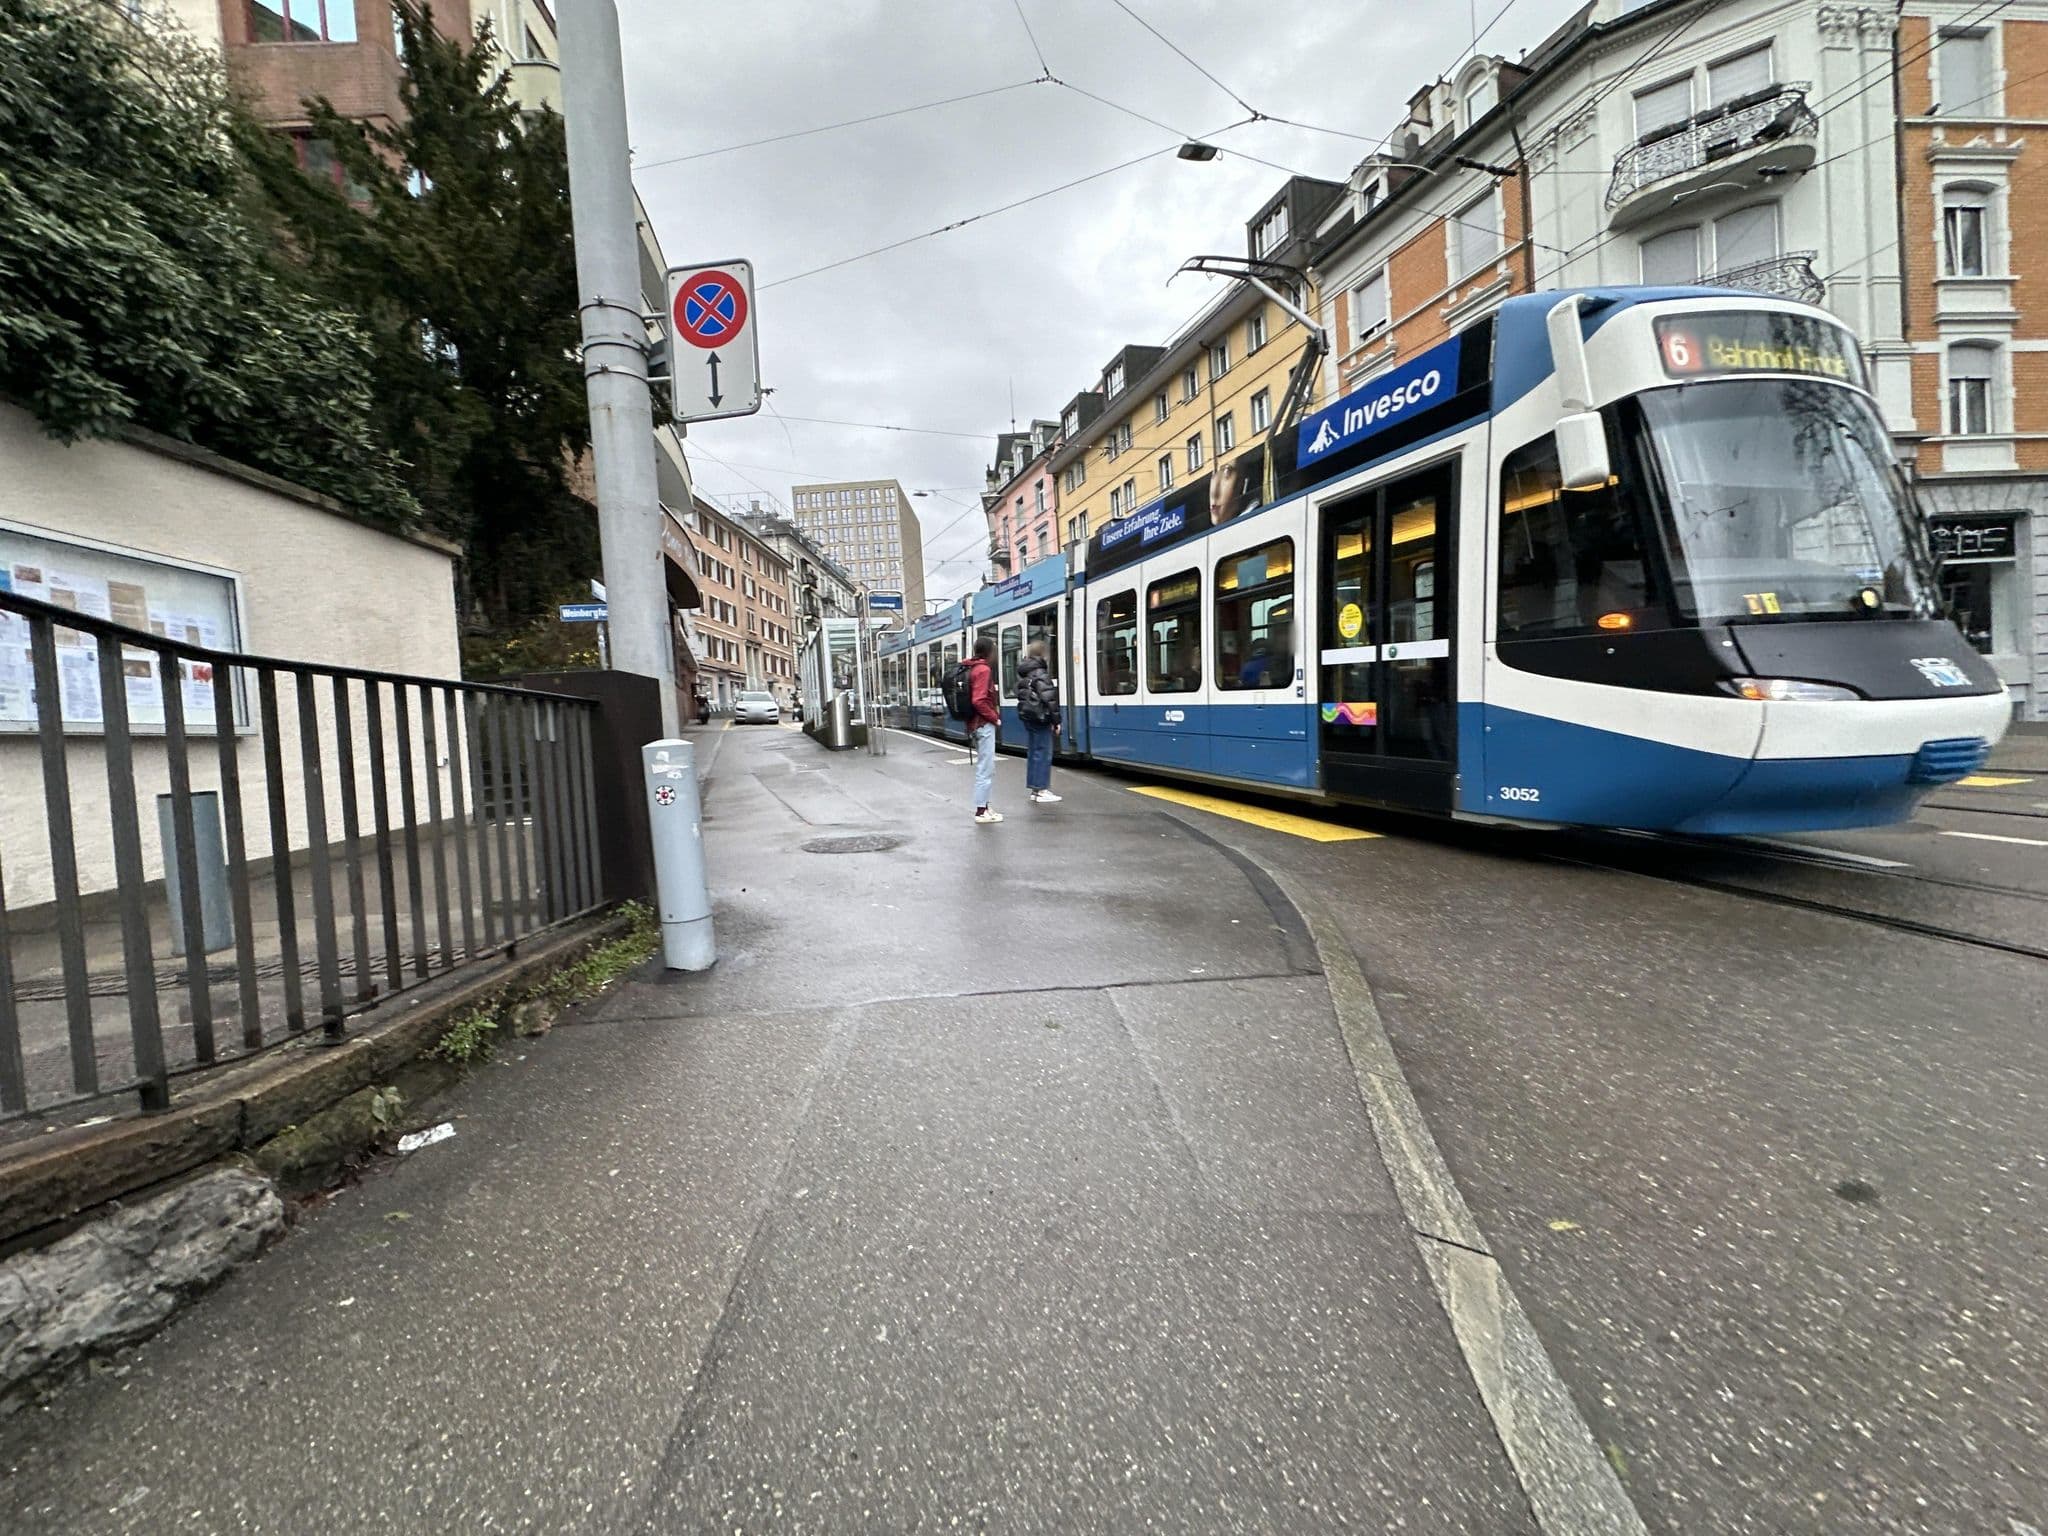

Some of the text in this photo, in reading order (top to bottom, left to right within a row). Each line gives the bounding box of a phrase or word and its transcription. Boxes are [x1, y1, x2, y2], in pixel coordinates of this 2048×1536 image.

[1669, 336, 1690, 366] 6
[1343, 370, 1441, 436] Invesco
[1102, 528, 1124, 546] Unsere
[1143, 513, 1183, 542] Ihre Ziele.
[1500, 786, 1540, 802] 3052
